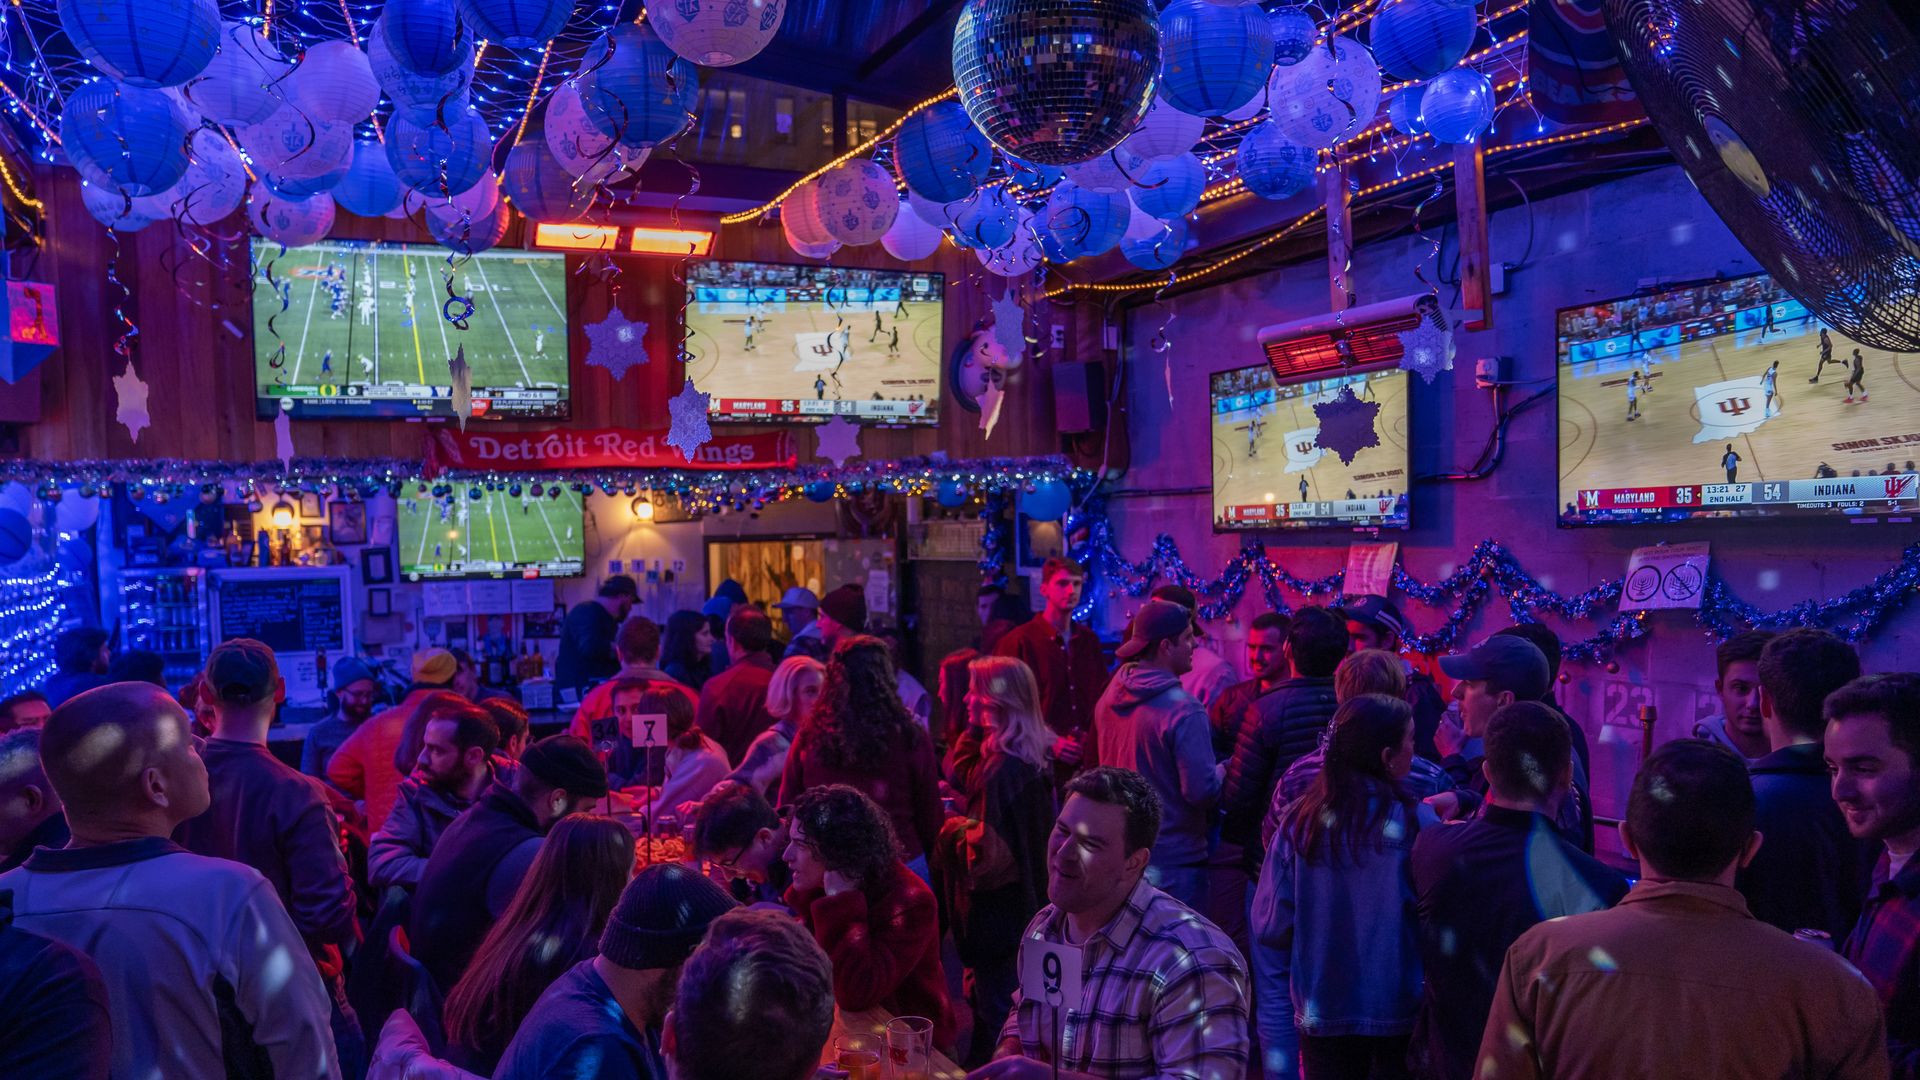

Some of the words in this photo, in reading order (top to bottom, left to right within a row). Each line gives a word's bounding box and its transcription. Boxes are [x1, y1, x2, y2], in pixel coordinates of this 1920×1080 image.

[781, 400, 794, 412] 35
[840, 401, 852, 413] 54
[469, 433, 588, 460] Detroit
[594, 432, 657, 463] Red
[1831, 438, 1881, 452] SIMON
[1676, 487, 1692, 504] 35
[1707, 485, 1729, 494] 13:21
[1735, 485, 1746, 493] 27
[1763, 483, 1782, 501] 54
[1814, 484, 1856, 496] INDIANA
[1613, 491, 1655, 504] MARYLAND
[1275, 504, 1286, 517] 35
[1320, 502, 1330, 515] 54
[1345, 503, 1366, 512] INDIANA
[1606, 683, 1654, 728] 23
[643, 720, 656, 741] 7
[1042, 951, 1062, 994] 9
